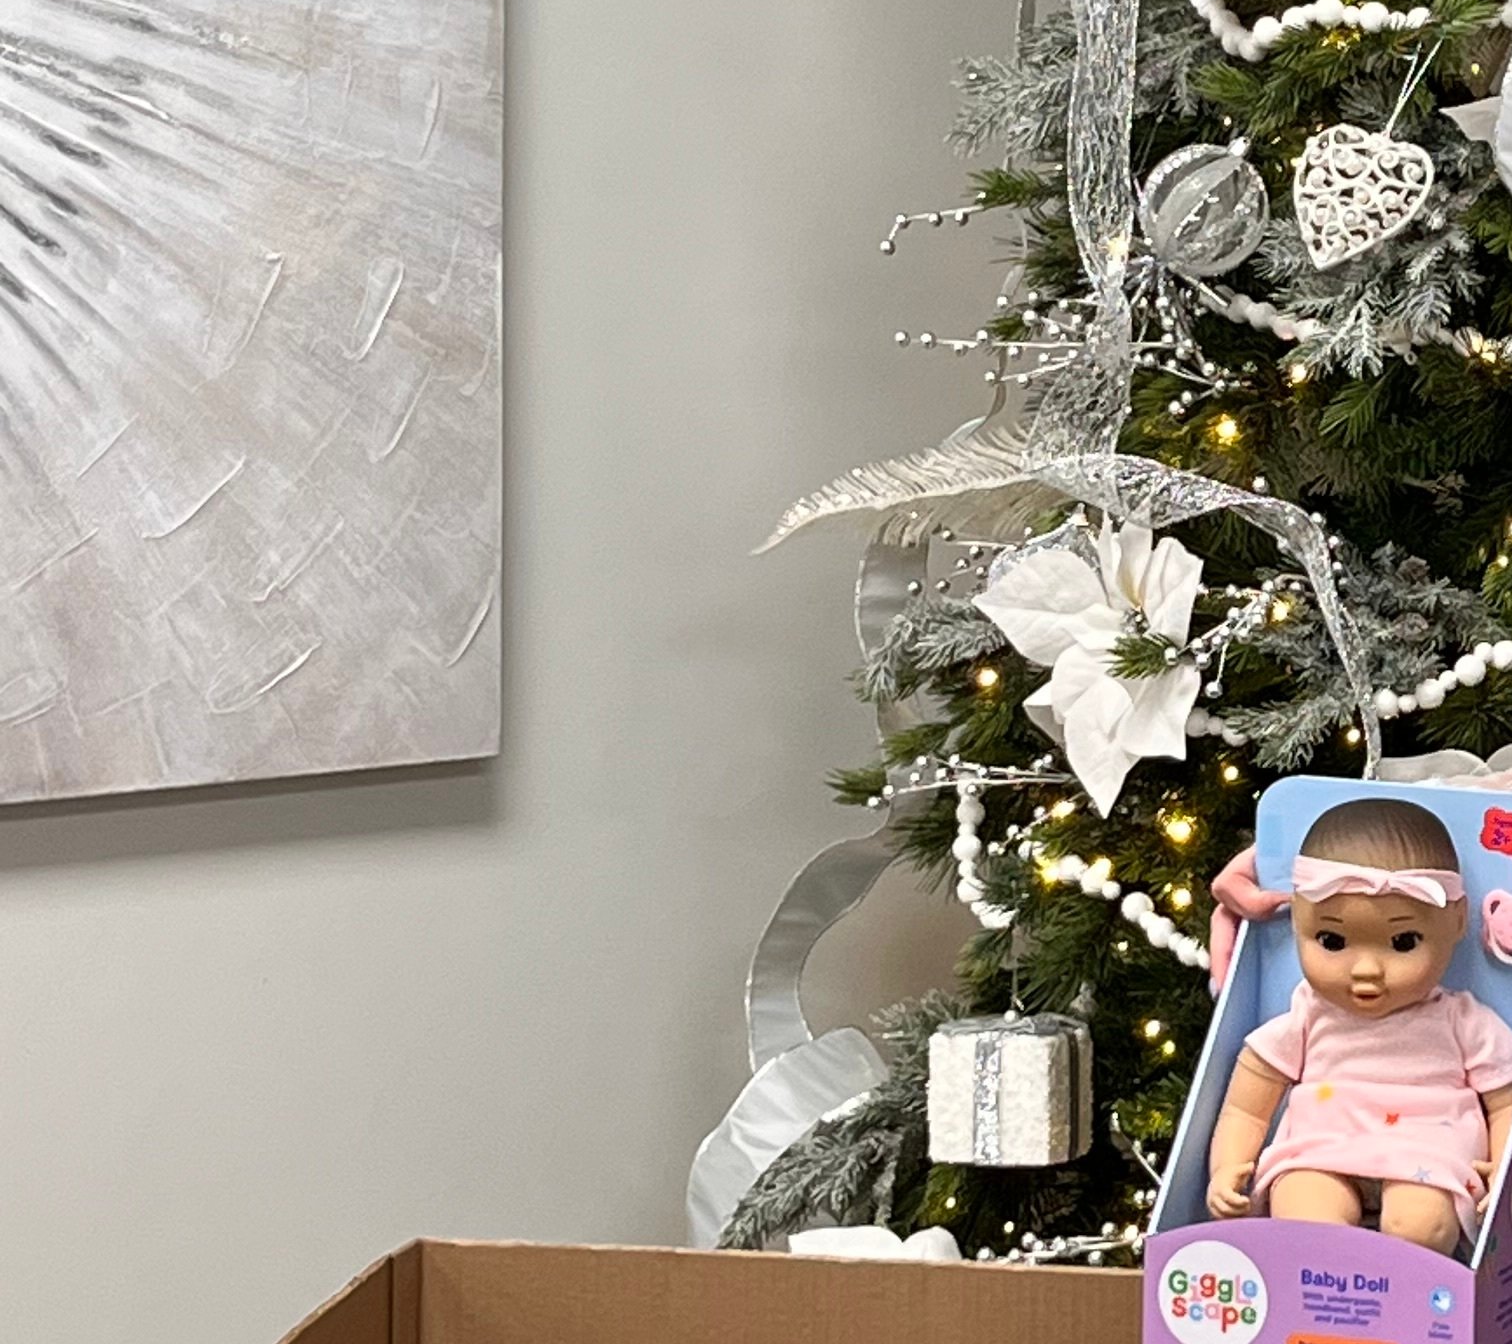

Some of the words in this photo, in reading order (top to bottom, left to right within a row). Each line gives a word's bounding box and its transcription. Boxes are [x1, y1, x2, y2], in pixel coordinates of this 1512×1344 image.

[1167, 1268, 1259, 1305] Giggle
[1300, 1268, 1347, 1292] Baby
[1352, 1273, 1389, 1293] Doll
